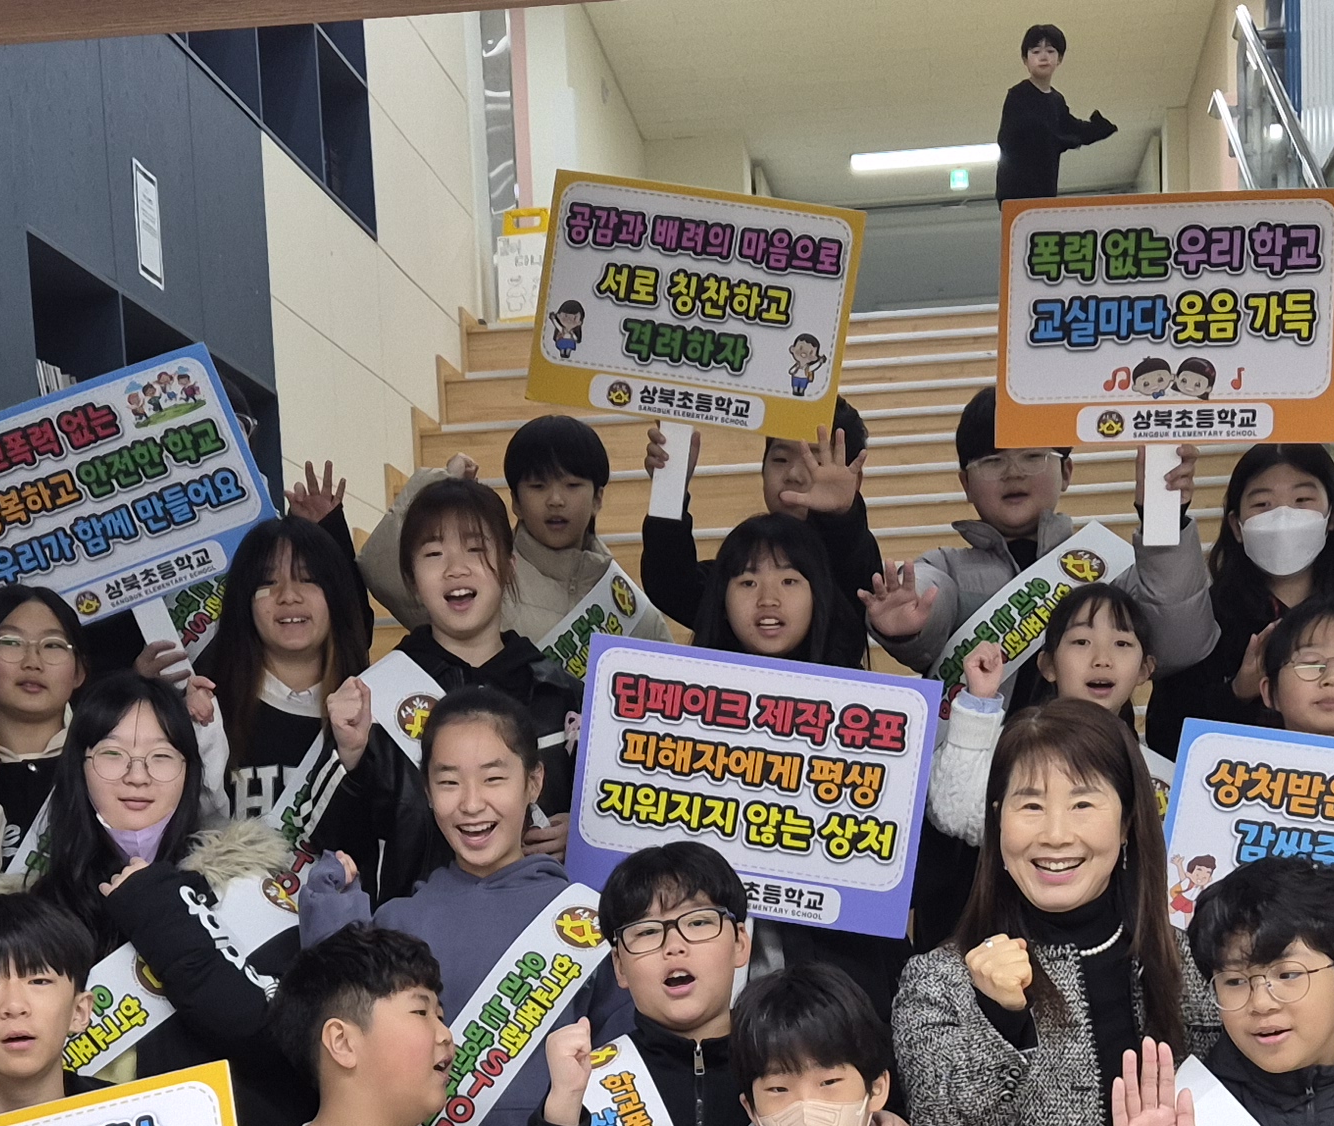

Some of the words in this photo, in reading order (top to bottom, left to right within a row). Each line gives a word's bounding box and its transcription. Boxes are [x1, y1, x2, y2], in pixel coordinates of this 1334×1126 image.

[567, 202, 647, 247] 공감과
[652, 214, 734, 262] 배려의
[740, 228, 843, 276] 마음으로
[1029, 229, 1097, 281] 폭력
[1101, 228, 1170, 280] 없는
[1174, 225, 1246, 274] 우리
[1249, 222, 1322, 276] 학교
[598, 263, 660, 307] 서로
[669, 270, 792, 324] 칭찬하고
[1030, 295, 1169, 346] 교실마다
[1172, 289, 1240, 343] 웃음
[1244, 289, 1316, 343] 가득
[623, 318, 750, 373] 격려하자
[57, 402, 122, 452] 없는
[639, 384, 751, 419] 상북초등학교
[1132, 409, 1258, 430] 상북초등학교
[76, 438, 169, 499] 안전한
[164, 417, 226, 463] 학교
[1225, 429, 1258, 437] SCHOOL
[74, 507, 139, 559] 함께
[135, 467, 247, 536] 만들어요
[104, 547, 214, 599] 상북초등학교
[989, 577, 1051, 636] 우리는
[613, 673, 749, 728] 딥페이크
[756, 694, 832, 745] 제작
[838, 706, 908, 752] 유포
[621, 731, 803, 792] 피해자에게
[810, 757, 884, 808] 평생
[599, 780, 739, 838] 지워지지
[745, 801, 815, 852] 않는
[820, 813, 898, 863] 상처
[743, 881, 824, 911] 초등학교
[791, 909, 822, 920] SCHOOL
[480, 949, 548, 1034] 우리는
